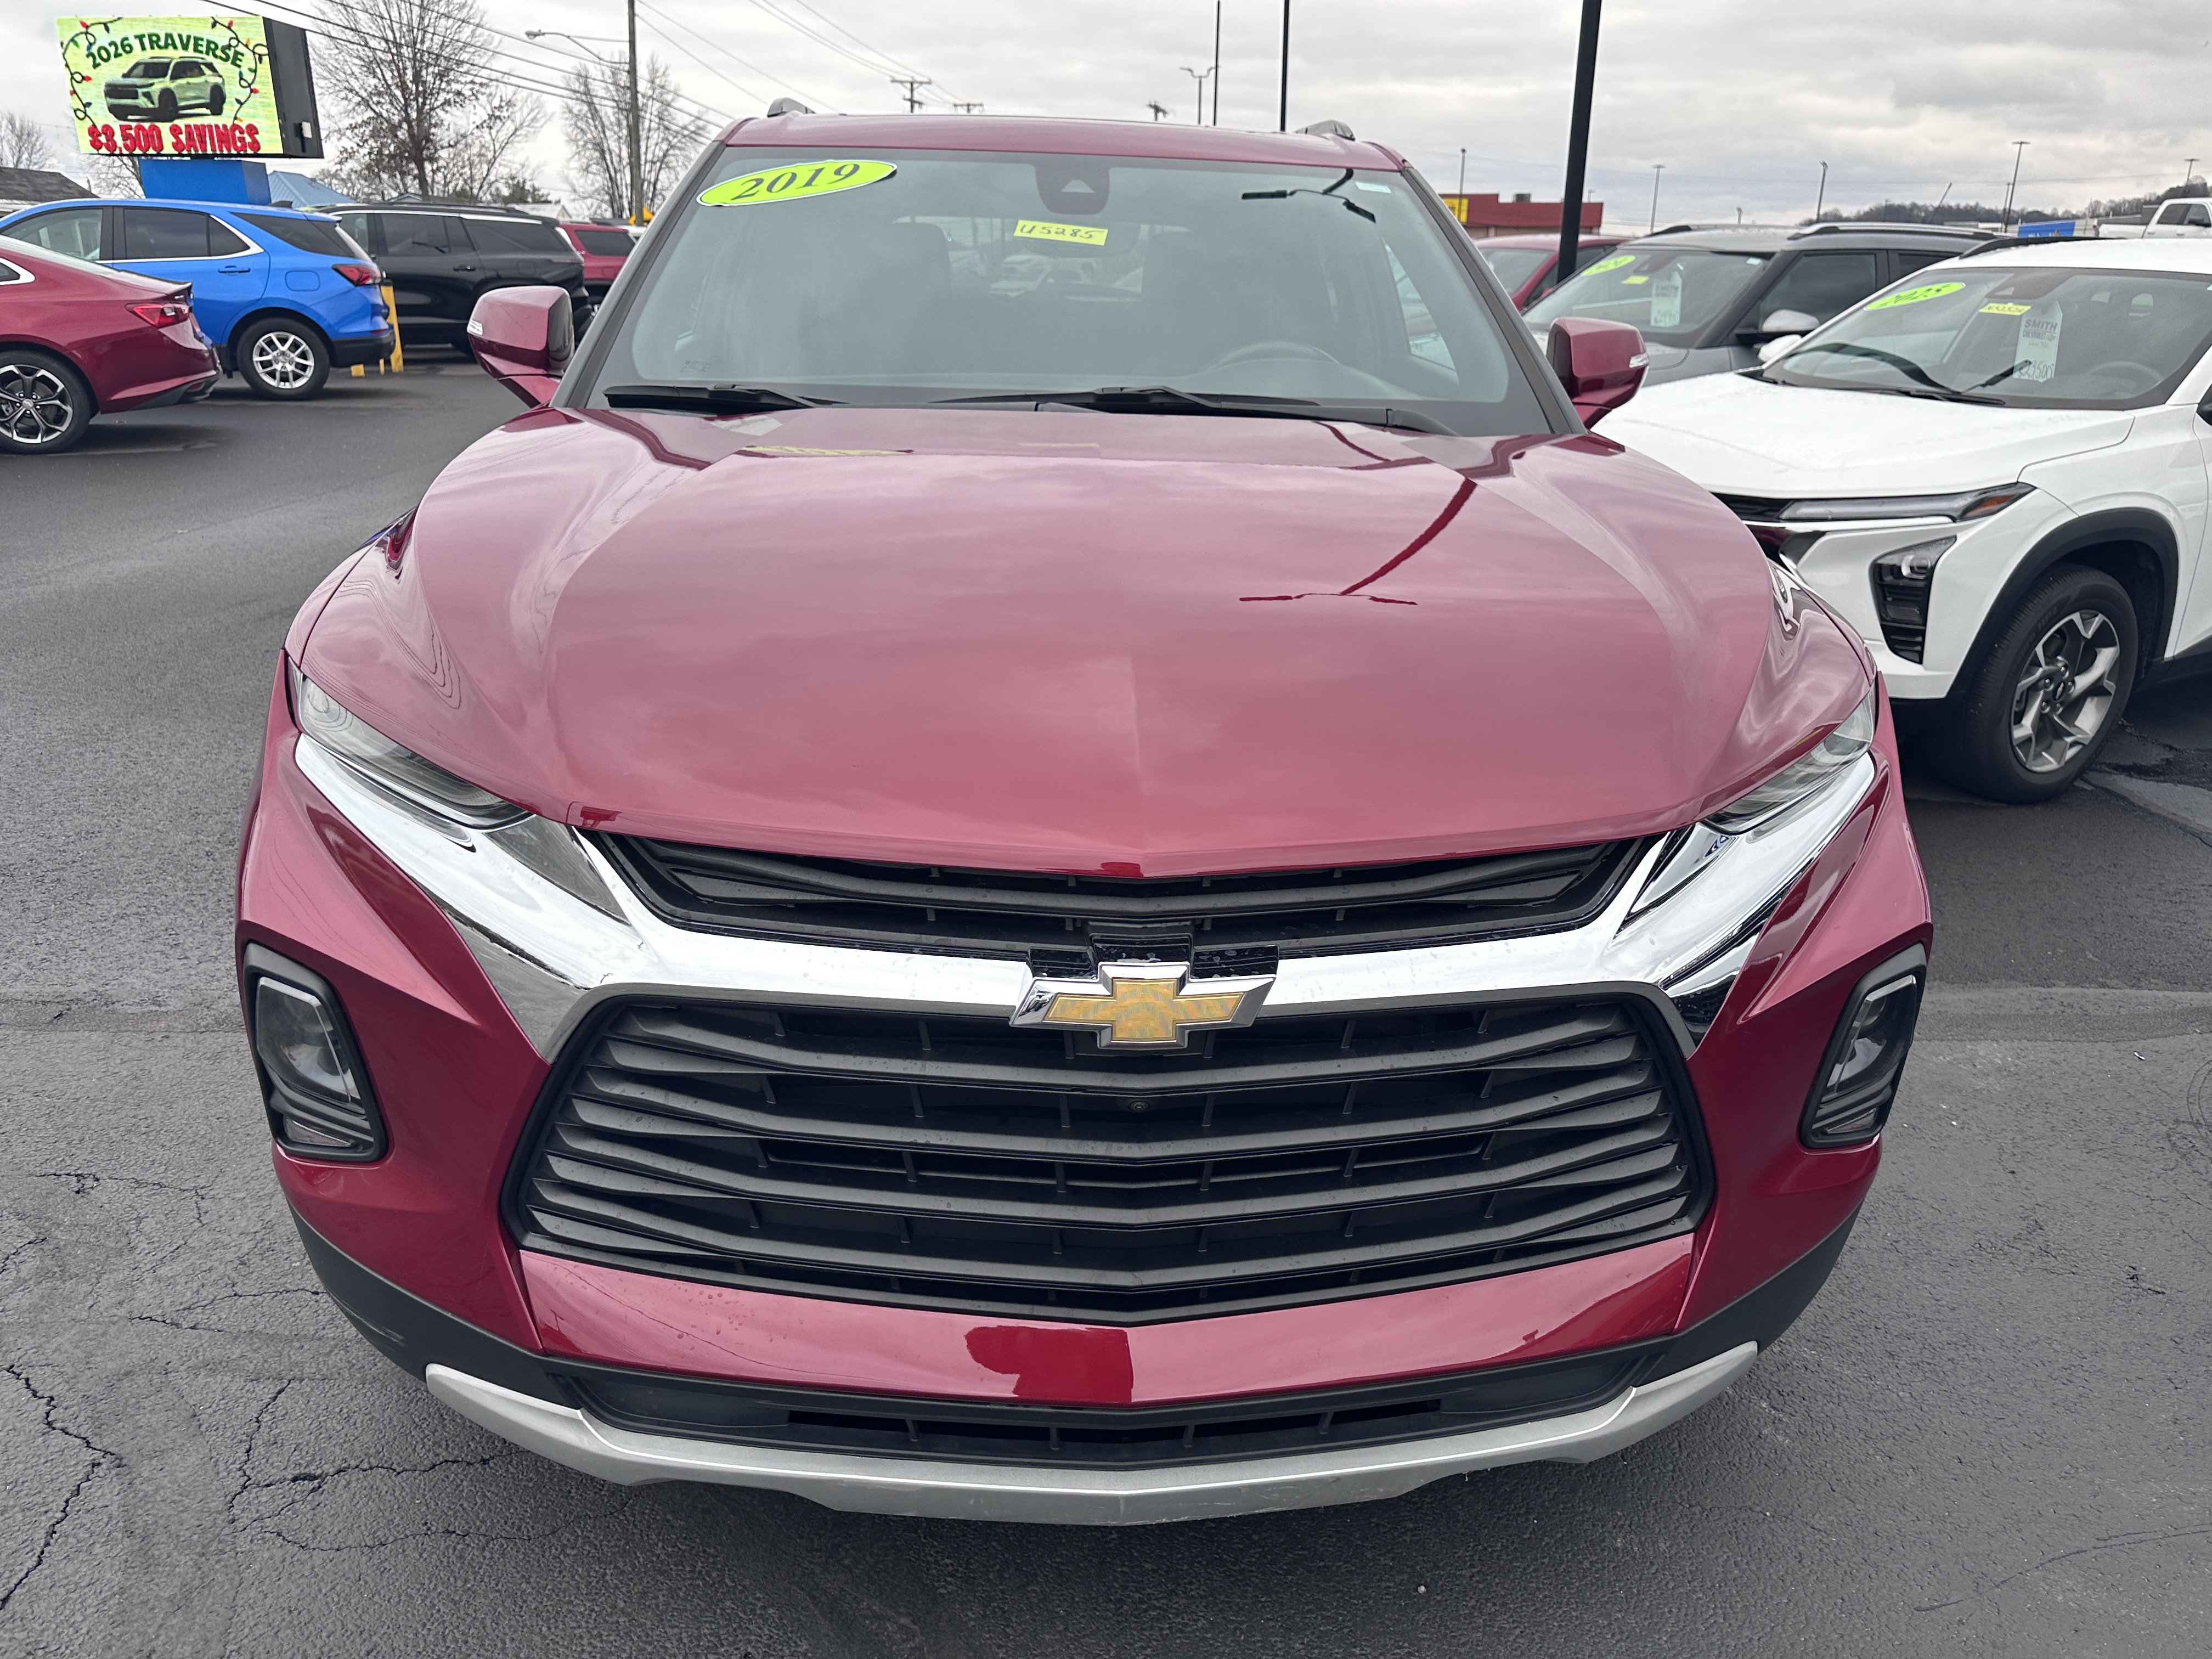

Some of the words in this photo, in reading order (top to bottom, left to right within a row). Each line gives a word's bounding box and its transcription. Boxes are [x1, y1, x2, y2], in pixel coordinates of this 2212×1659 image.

[86, 36, 134, 69] 2026
[134, 32, 245, 68] TRAVERSE
[87, 123, 163, 154] $3,500
[169, 123, 261, 154] SAVINGS
[730, 163, 860, 200] 2019
[2024, 319, 2058, 331] SMITH
